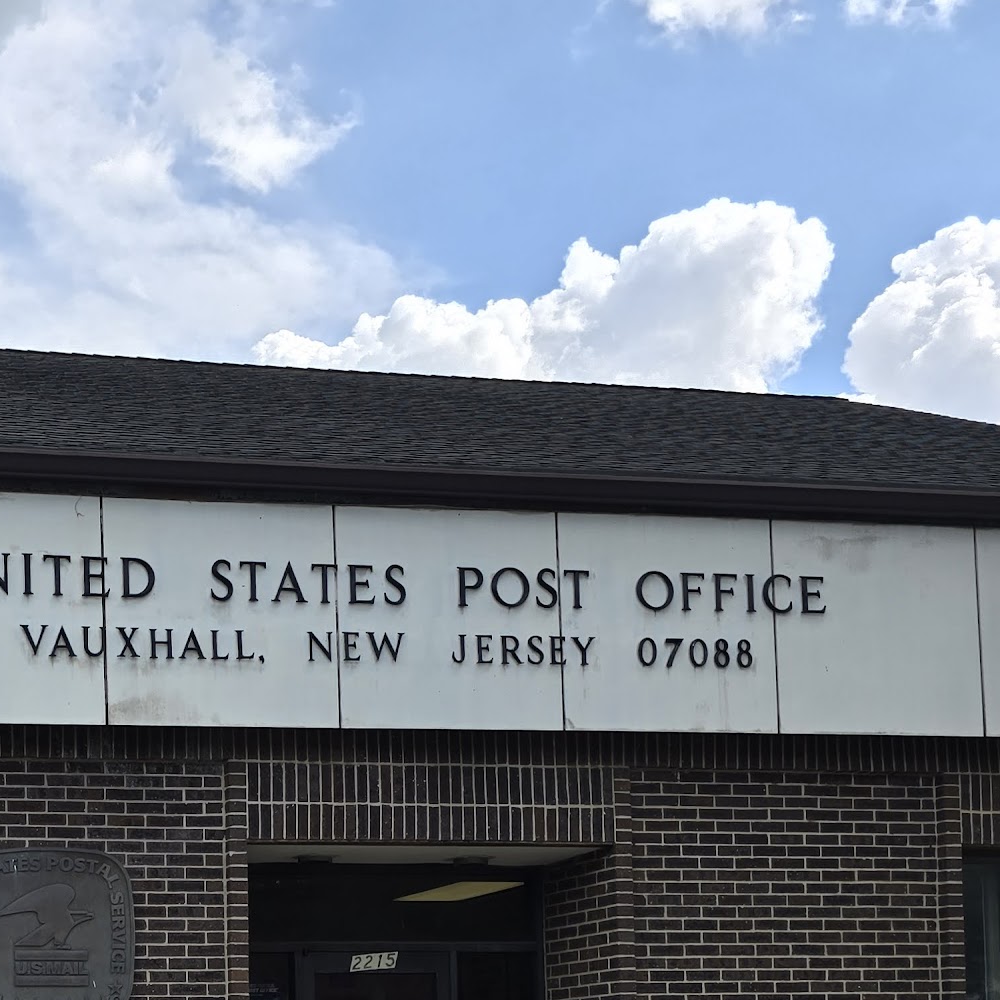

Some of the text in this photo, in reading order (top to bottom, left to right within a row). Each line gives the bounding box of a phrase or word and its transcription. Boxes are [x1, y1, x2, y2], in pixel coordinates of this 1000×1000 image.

[210, 559, 407, 607] STATES
[456, 566, 590, 611] POST
[635, 570, 827, 616] OFFICE
[20, 624, 753, 670] VAUXHALL, NEW JERSEY 07088
[46, 857, 120, 889] POSTAL
[110, 891, 127, 975] SERVICE
[352, 953, 396, 970] 2215
